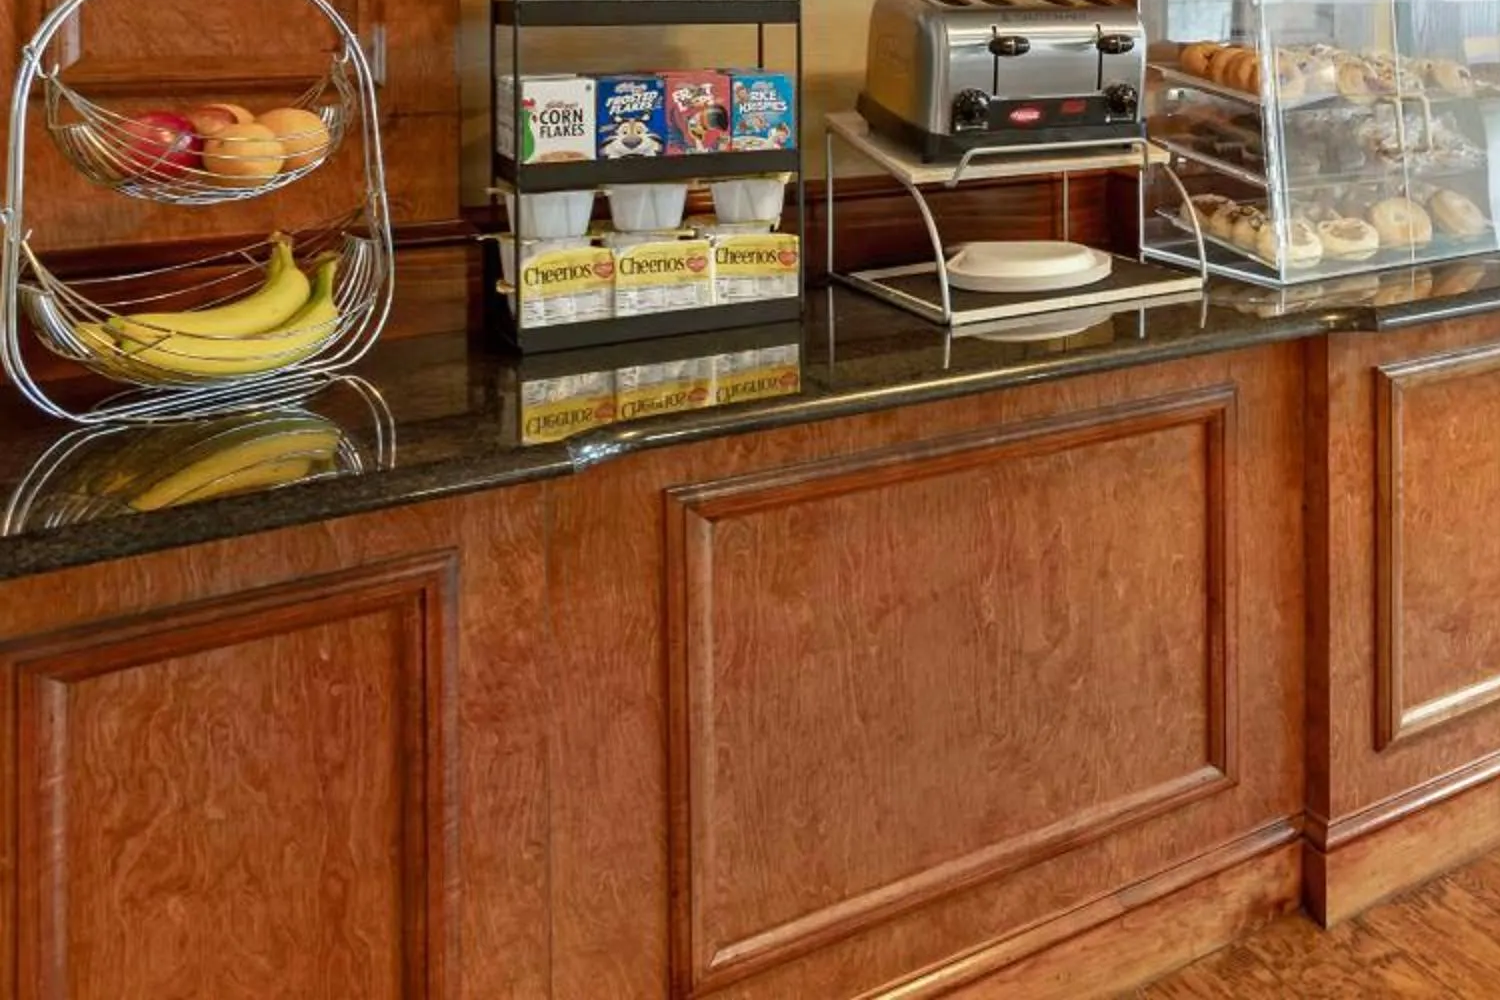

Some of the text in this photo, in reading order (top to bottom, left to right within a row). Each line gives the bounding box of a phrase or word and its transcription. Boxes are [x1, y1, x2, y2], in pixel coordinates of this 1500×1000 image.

[539, 108, 584, 125] CORN
[539, 123, 586, 139] FLAKES
[715, 248, 777, 265] Cheerios
[618, 255, 686, 276] Cheerios
[523, 263, 592, 286] Cheerios
